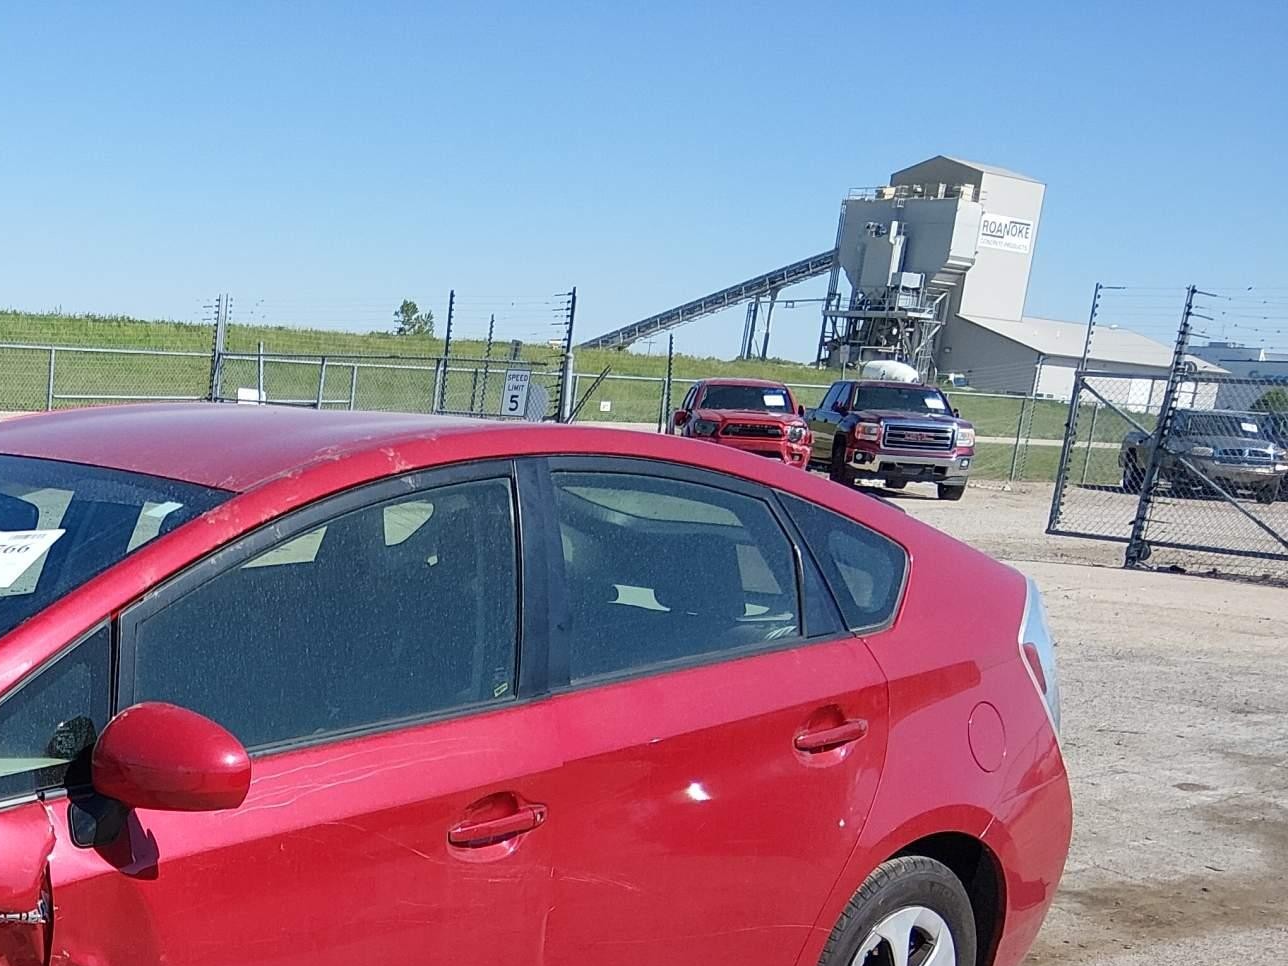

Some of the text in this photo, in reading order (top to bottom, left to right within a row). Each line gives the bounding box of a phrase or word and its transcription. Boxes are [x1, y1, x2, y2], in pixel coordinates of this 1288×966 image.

[982, 219, 1030, 239] ROANOKE
[507, 374, 528, 382] SPEED
[507, 384, 525, 392] LIMIT
[508, 394, 520, 412] 5
